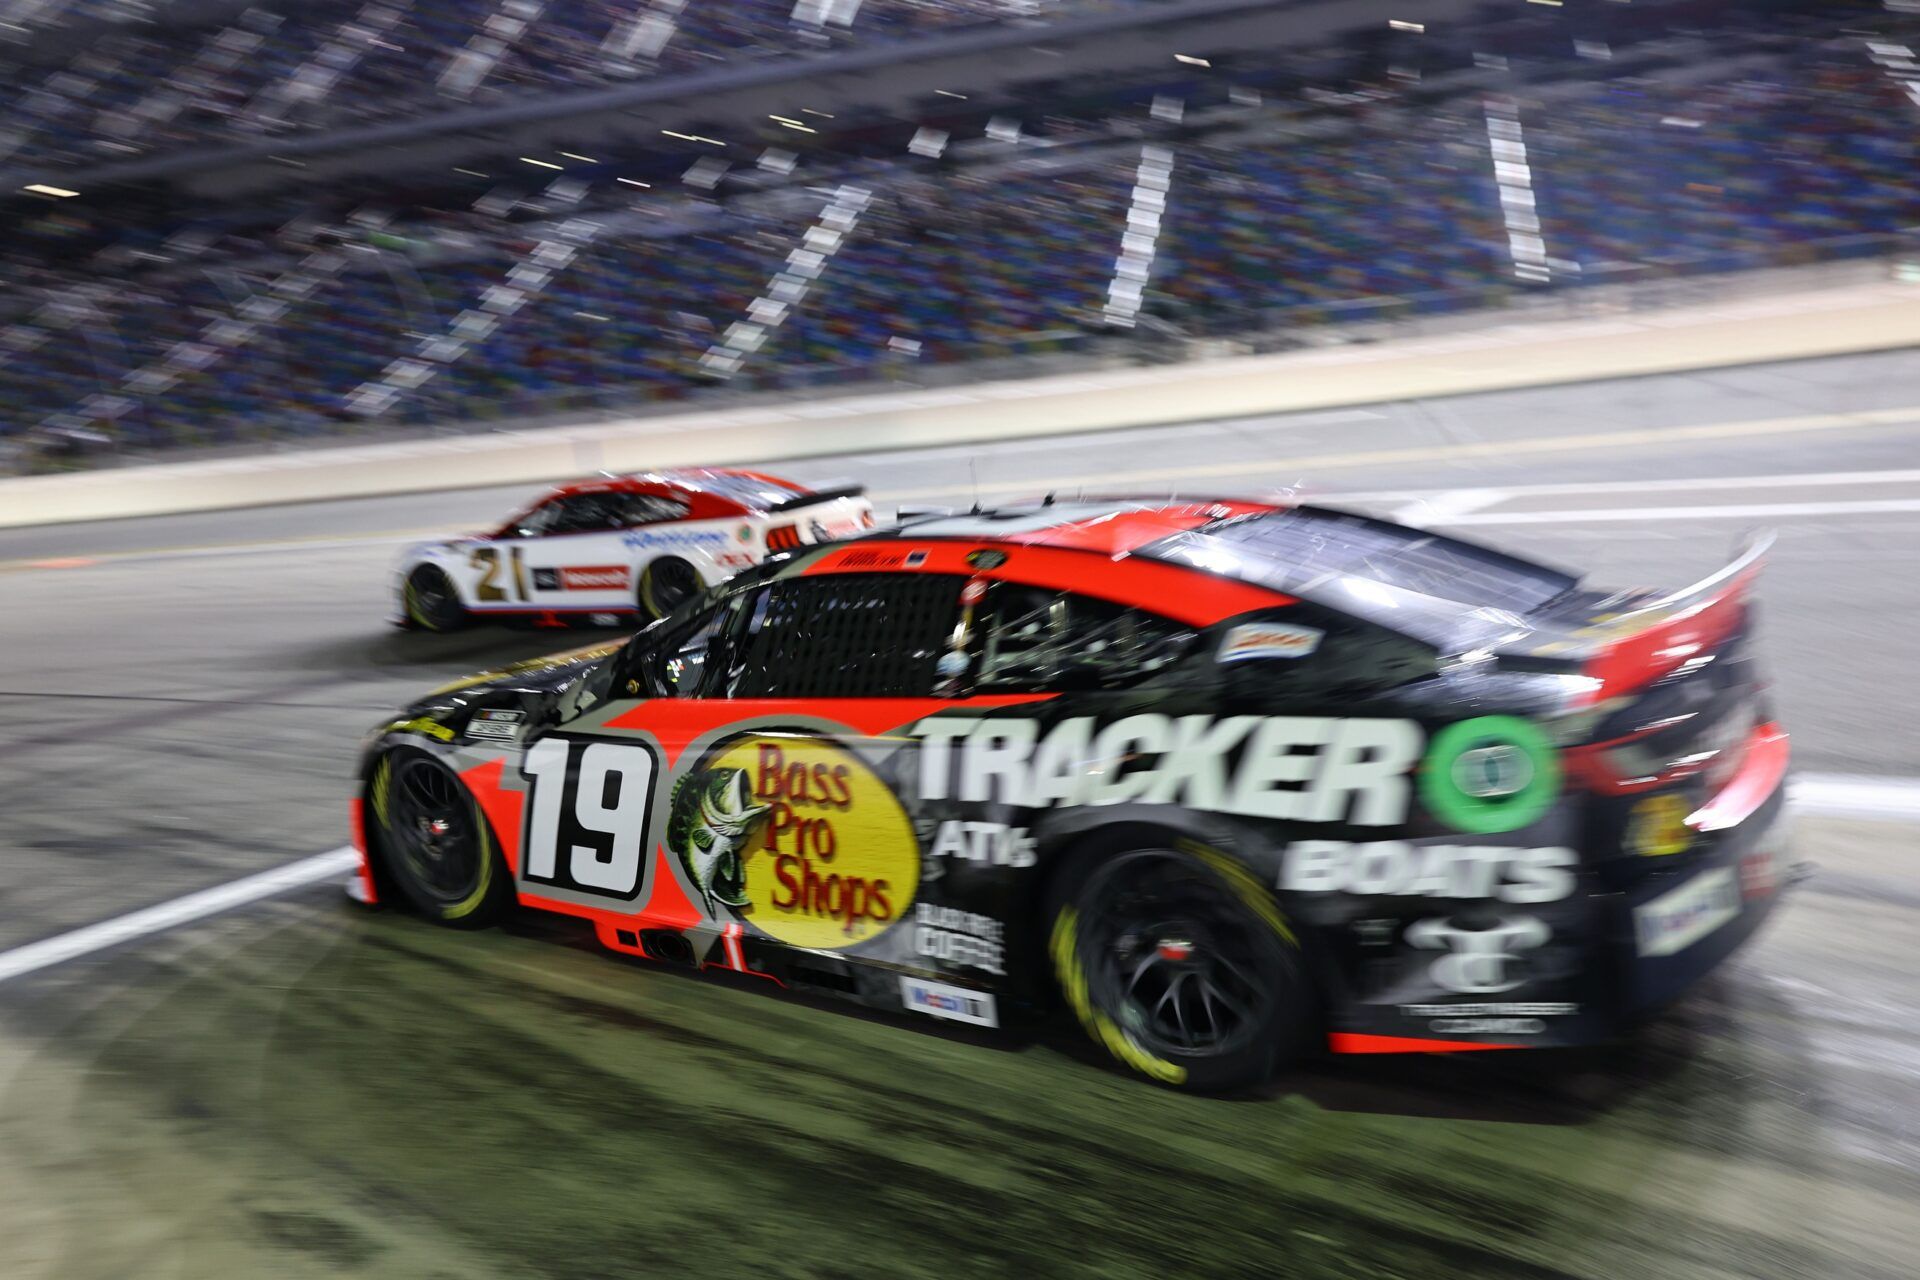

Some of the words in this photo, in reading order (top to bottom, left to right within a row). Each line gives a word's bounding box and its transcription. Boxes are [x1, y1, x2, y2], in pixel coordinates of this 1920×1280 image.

[470, 547, 530, 602] 21
[757, 743, 851, 807] Bass
[912, 714, 1422, 826] TRACKER
[523, 737, 653, 893] 19
[765, 802, 835, 859] Pro
[772, 853, 894, 932] Shops
[1279, 840, 1580, 903] BOATS
